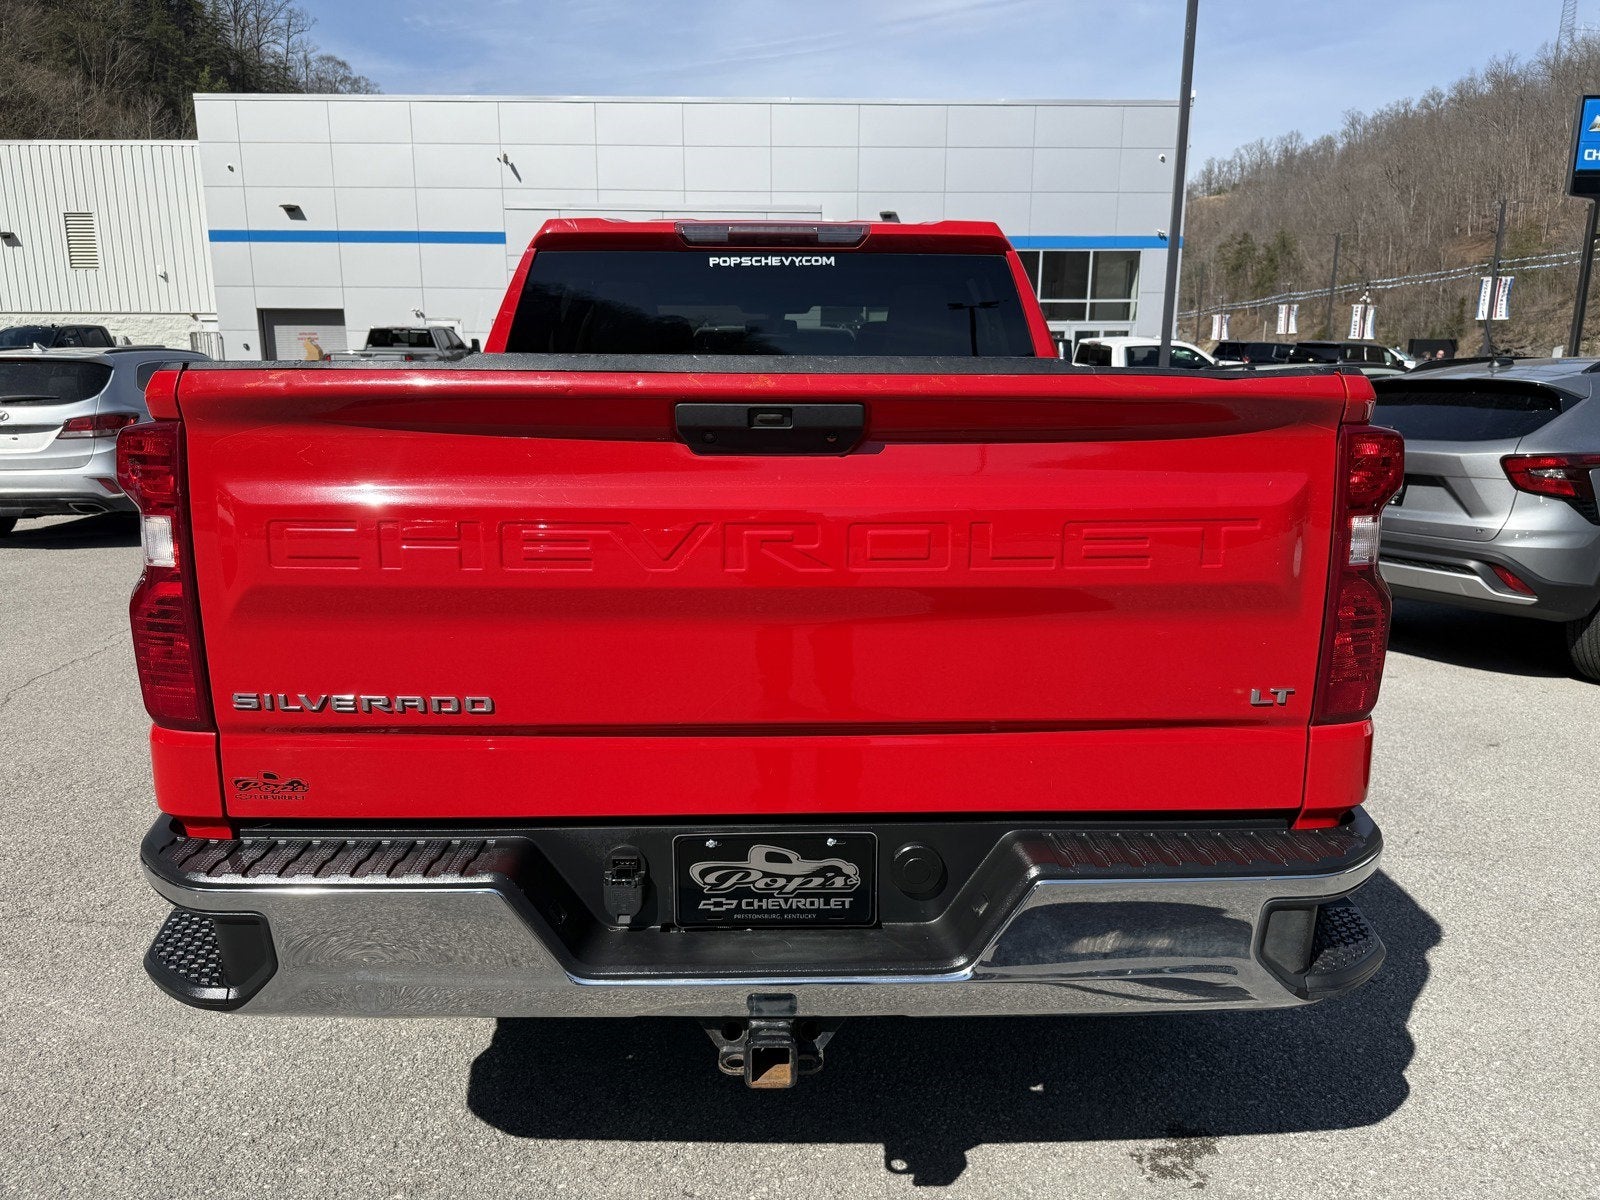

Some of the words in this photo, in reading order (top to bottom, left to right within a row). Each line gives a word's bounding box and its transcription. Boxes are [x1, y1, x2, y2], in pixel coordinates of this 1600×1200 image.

[709, 255, 836, 267] POPSCHEVY.COM
[266, 518, 1262, 573] CHEVROLET
[232, 692, 495, 715] SILVERADO
[1250, 688, 1295, 707] LT
[704, 870, 848, 894] Pop's
[741, 897, 854, 910] CHEVROLET
